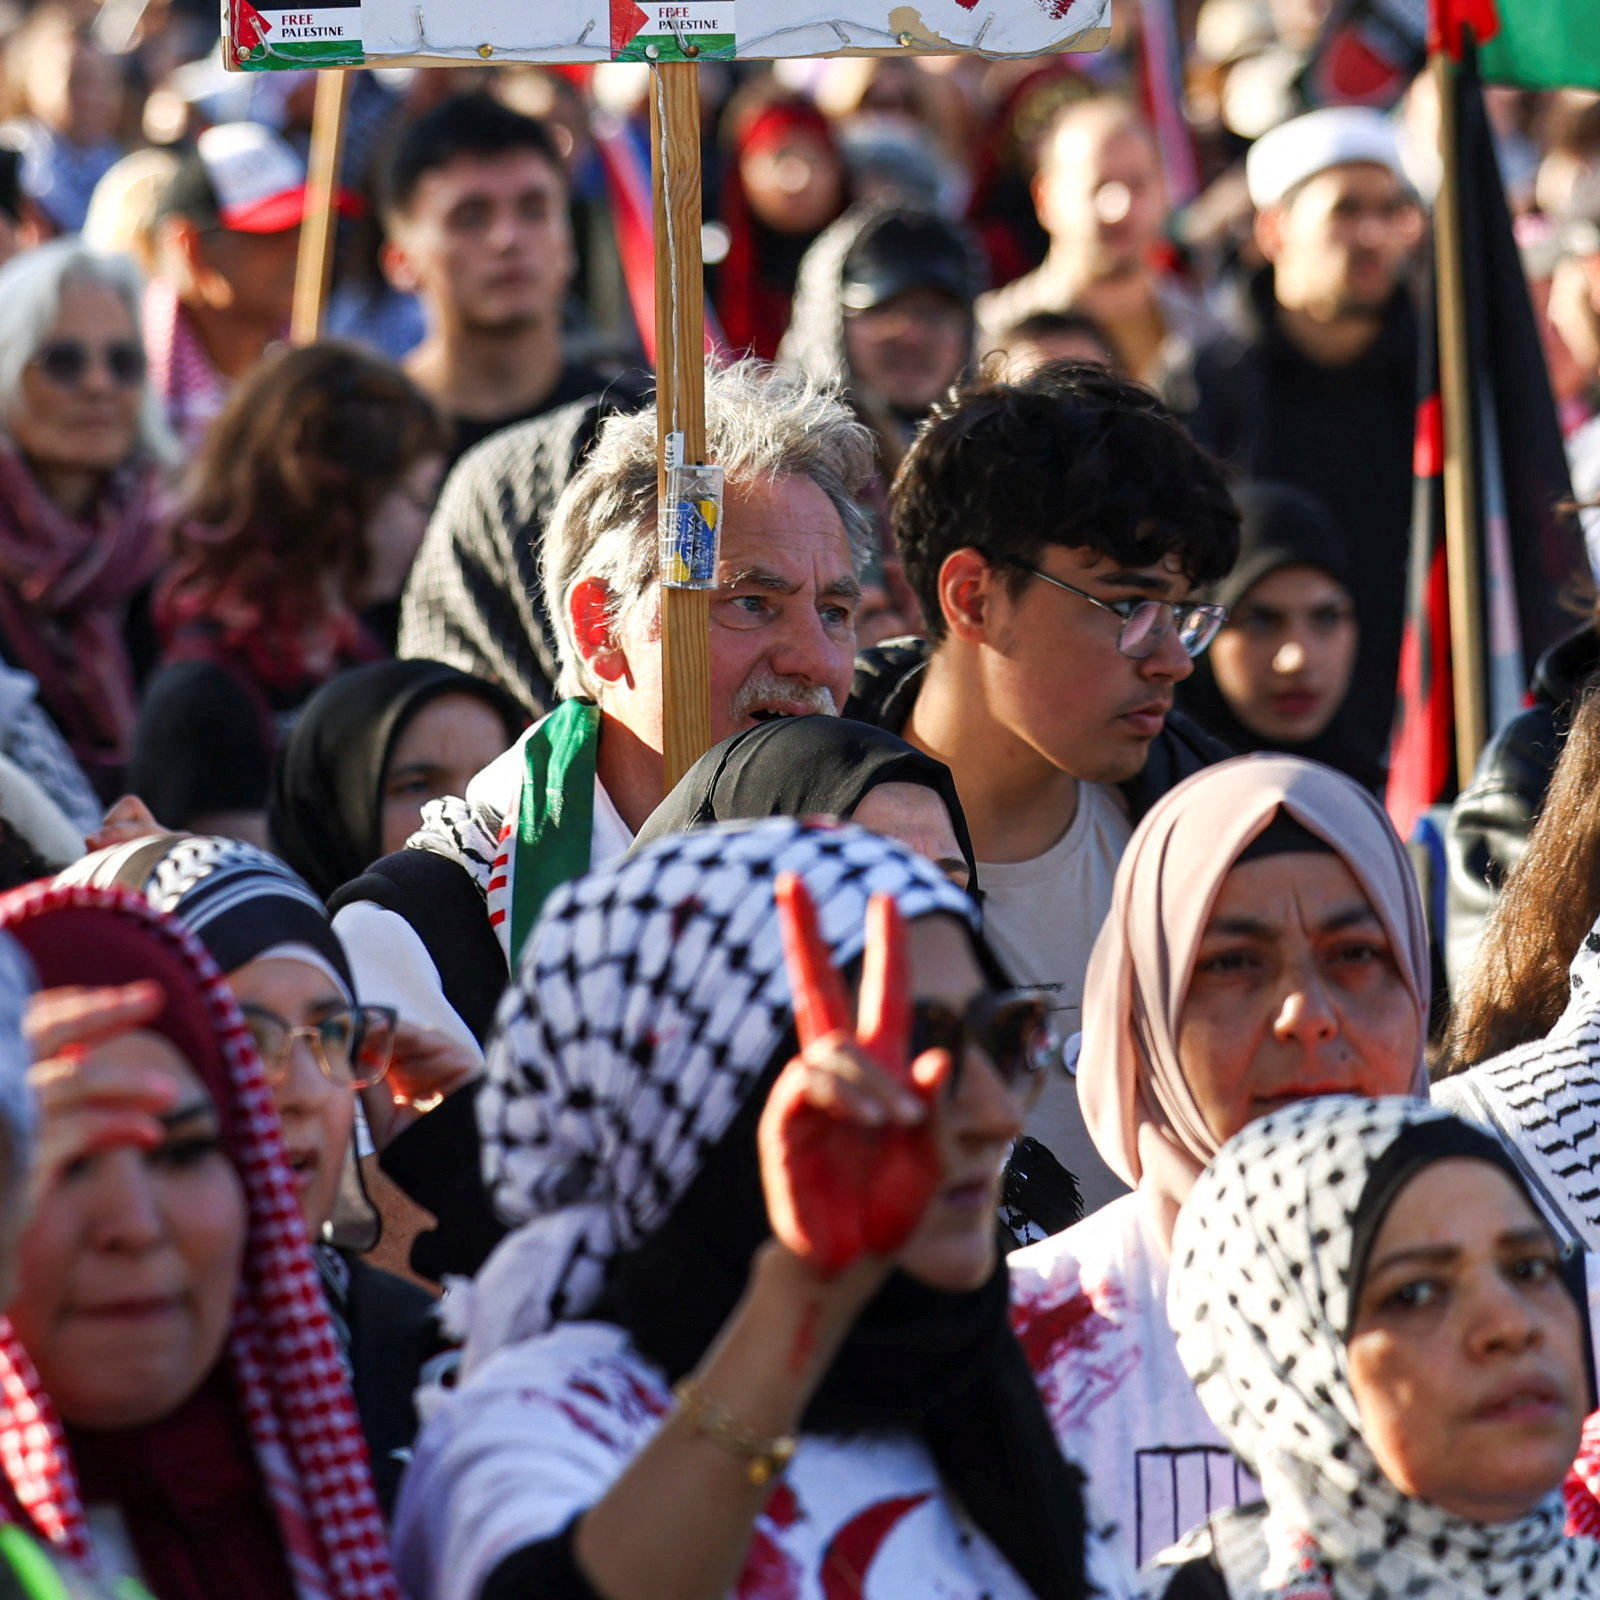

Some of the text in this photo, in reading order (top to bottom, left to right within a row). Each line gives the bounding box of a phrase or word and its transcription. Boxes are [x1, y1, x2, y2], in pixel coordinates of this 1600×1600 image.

[658, 7, 690, 18] FREE
[281, 14, 314, 26] FREE
[658, 19, 719, 30] PAESTINE
[281, 26, 344, 38] PALESTINE
[686, 515, 695, 563] VARTA
